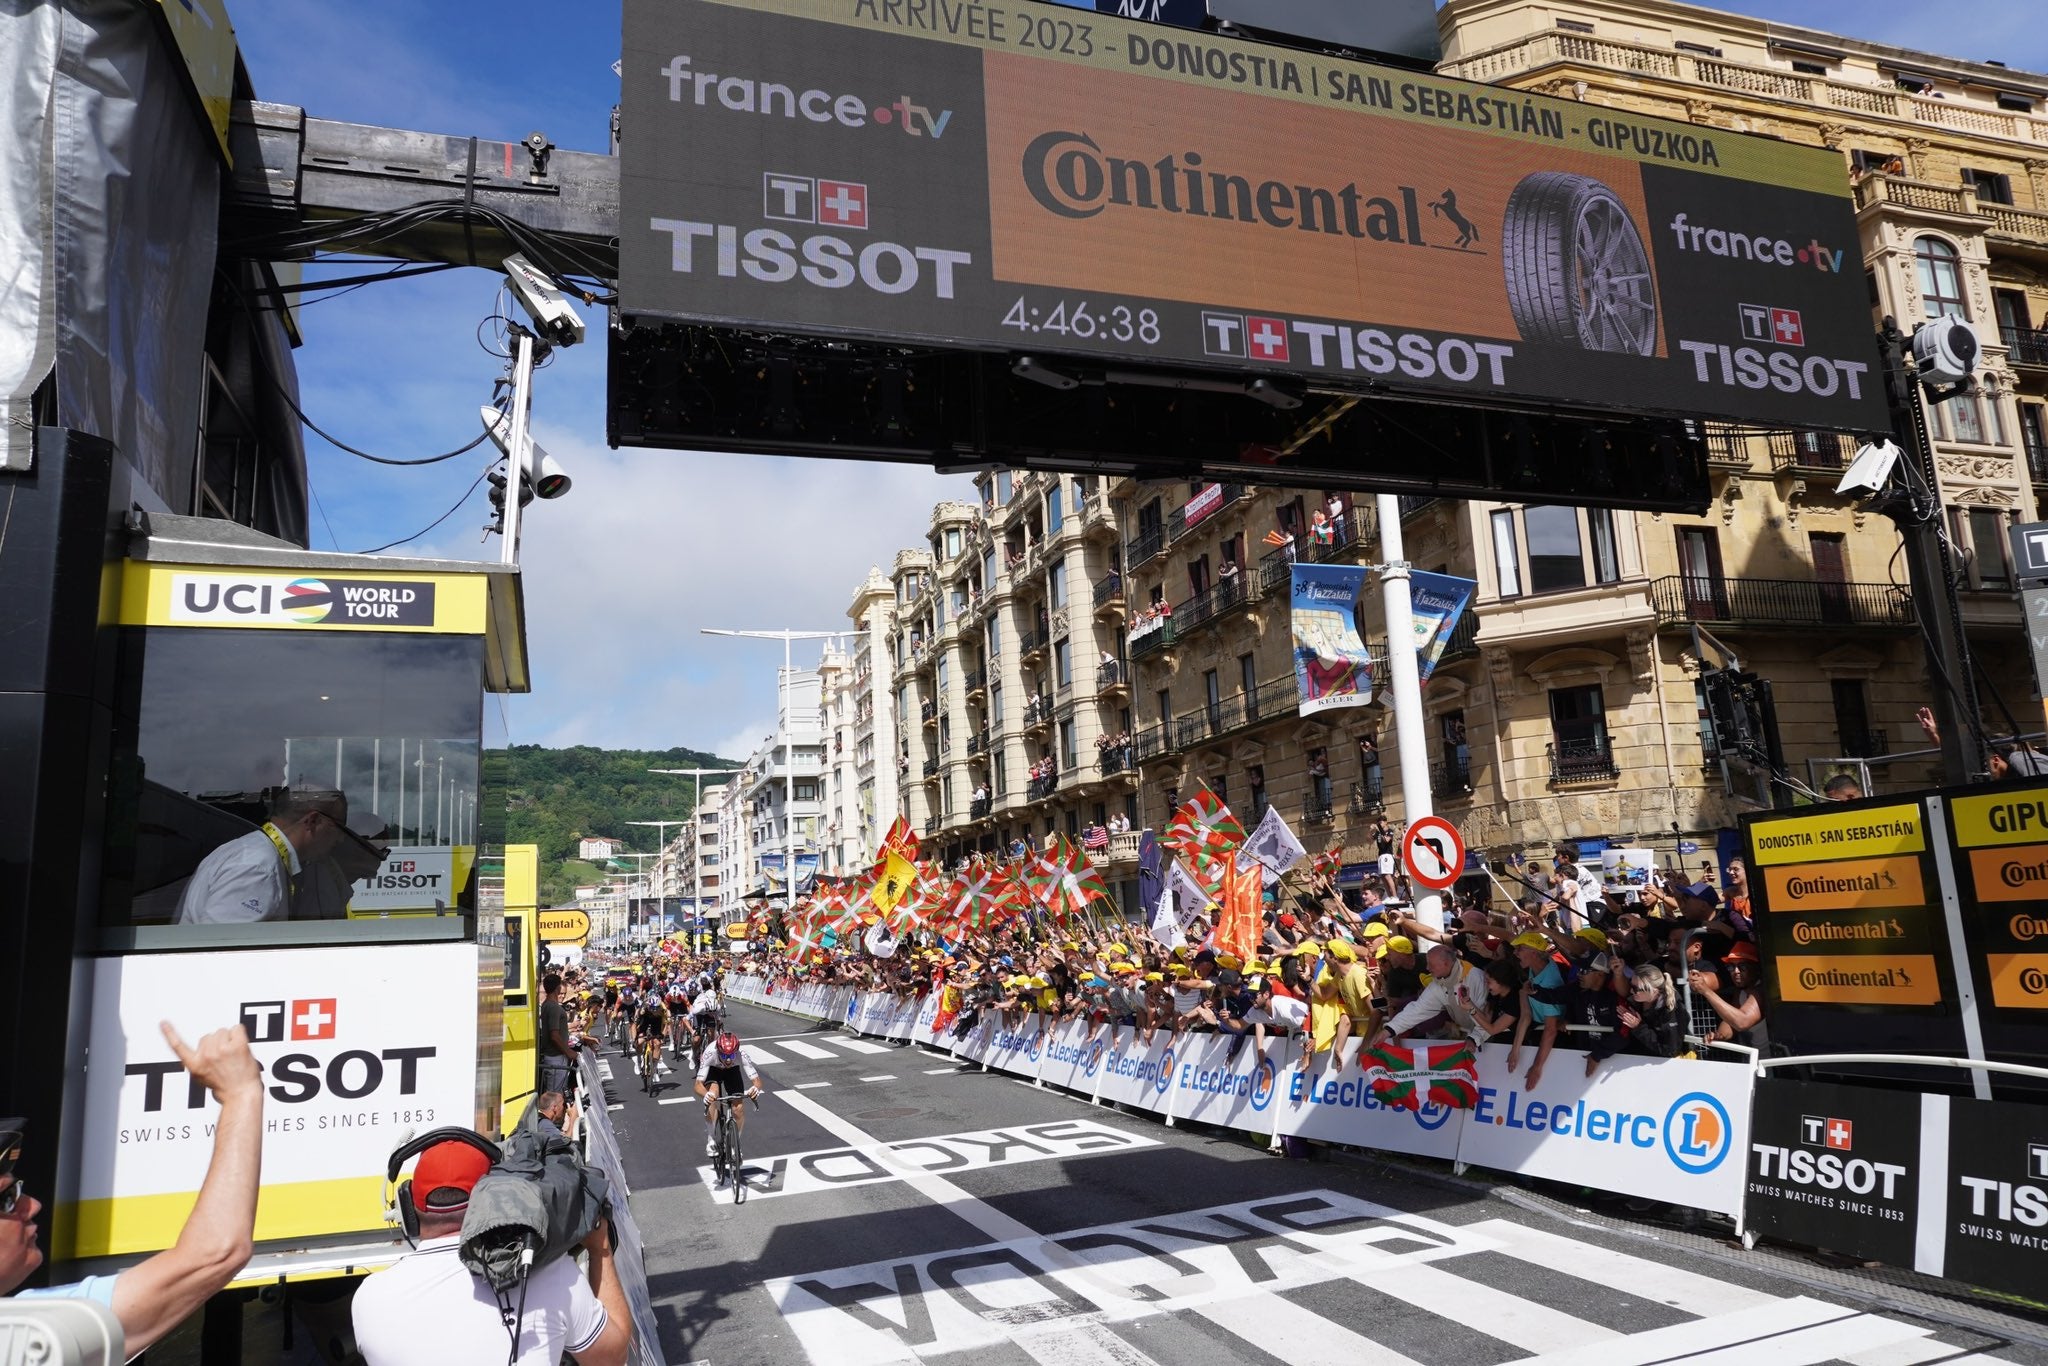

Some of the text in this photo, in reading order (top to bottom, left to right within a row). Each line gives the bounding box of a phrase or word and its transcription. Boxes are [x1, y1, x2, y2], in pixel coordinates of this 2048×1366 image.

[1017, 14, 1093, 57] 2023
[1127, 34, 1303, 94] DONOSTIA
[1329, 70, 1394, 109] SAN
[1402, 84, 1564, 140] SEBASTIÁN
[1588, 118, 1719, 167] GIPUZKOA
[1022, 130, 1426, 246] Continental
[650, 217, 972, 299] TISSOT
[1001, 295, 1161, 345] 4:46:38
[1292, 321, 1513, 385] TISSOT
[1679, 340, 1868, 400] TISSOT
[184, 583, 272, 614] UCI
[343, 587, 416, 604] WORLD
[345, 602, 399, 619] TOUR
[1319, 696, 1353, 706] KELER
[1759, 832, 1813, 850] DONOSTIA
[1820, 829, 1844, 844] SAN
[1847, 820, 1914, 841] SEBASTIÁN
[1786, 872, 1880, 900] Continental
[1792, 920, 1887, 945] Continental
[2009, 914, 2048, 941] Con
[1799, 968, 1896, 990] Continental
[125, 1046, 436, 1112] TISOT
[1106, 1051, 1156, 1082] E.Leclerc
[1180, 1064, 1248, 1097] E.Leclerc
[1289, 1071, 1406, 1113] E.Lecle
[120, 1109, 436, 1144] SWISS WHES SINCE 1853
[1474, 1087, 1656, 1148] E.Leclerc
[1752, 1143, 1906, 1200] TISSOT
[1749, 1183, 1904, 1222] SWISS WATCHES SINCE 1853
[1960, 1223, 2003, 1241] SWISS
